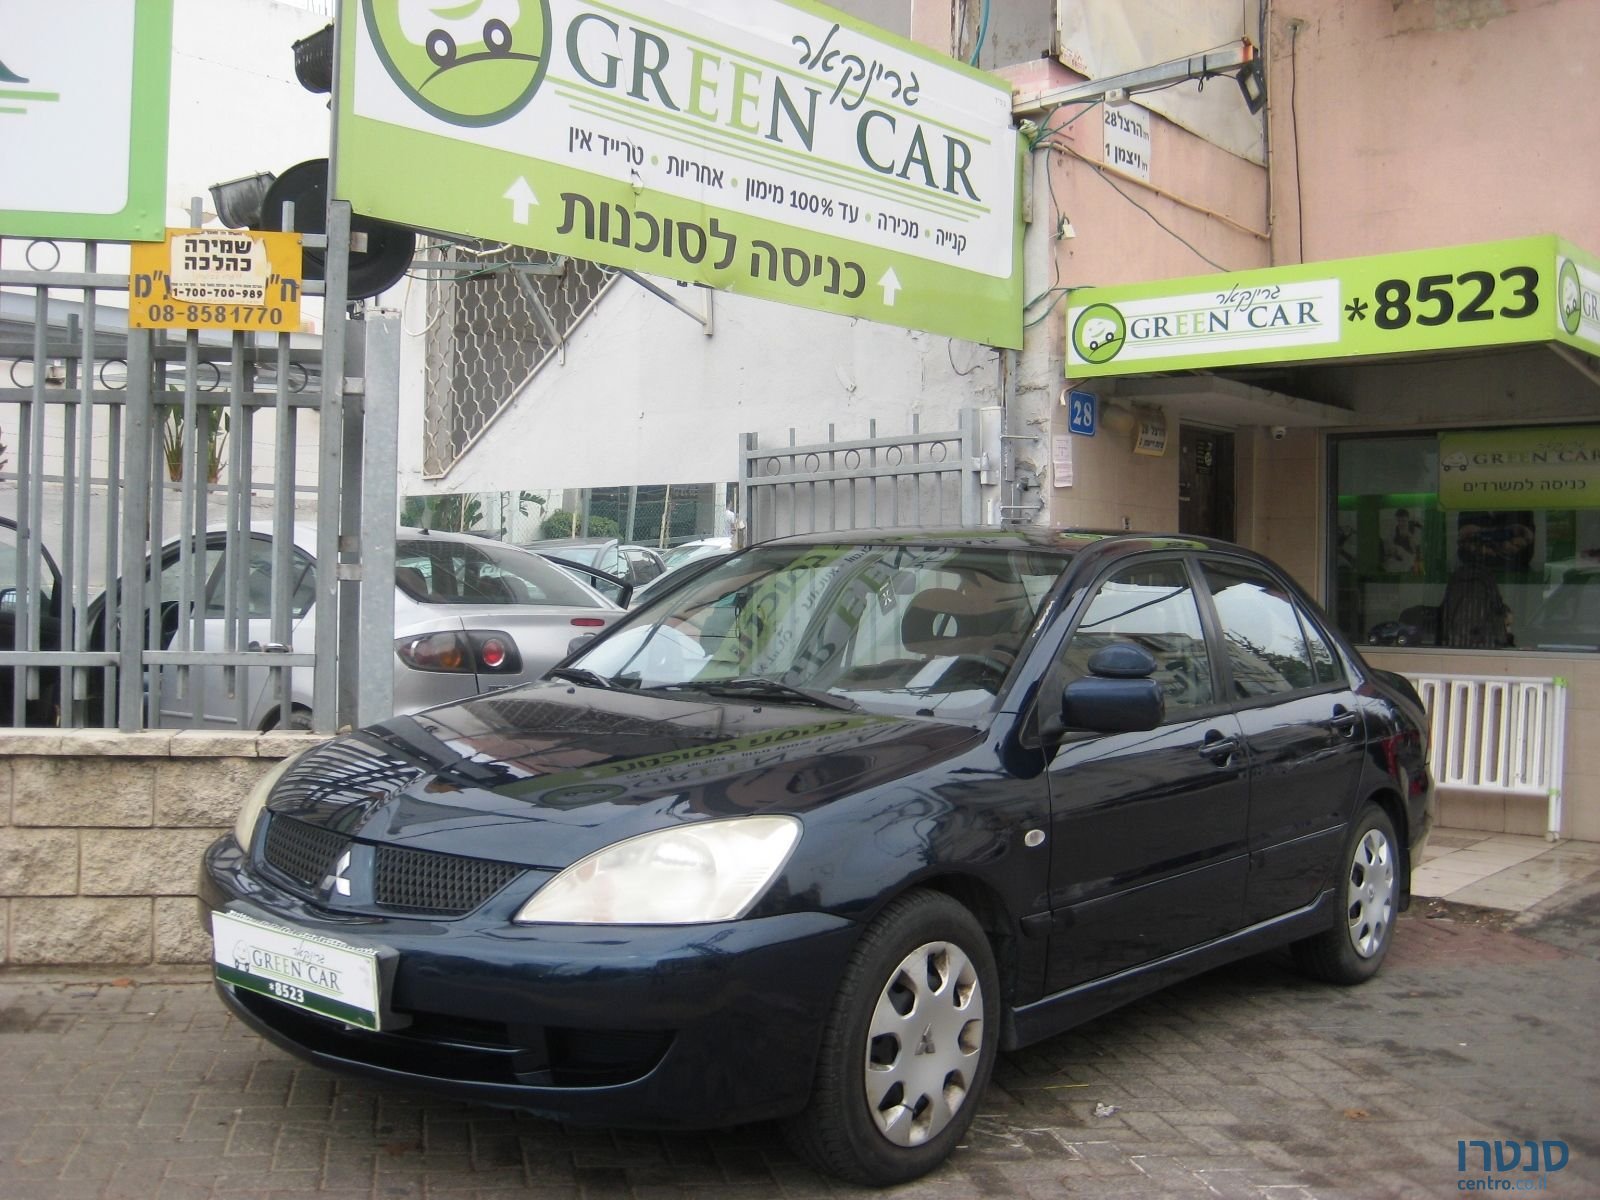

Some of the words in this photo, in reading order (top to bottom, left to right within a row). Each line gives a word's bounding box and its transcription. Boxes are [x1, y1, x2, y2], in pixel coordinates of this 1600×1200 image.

[566, 13, 822, 152] GREEN
[856, 109, 981, 202] CAR
[569, 126, 592, 152] אין
[598, 134, 644, 165] טרייד
[1104, 143, 1110, 157] 1
[1114, 146, 1141, 168] ויצמן
[666, 156, 724, 188] אחריות
[746, 178, 784, 205] מימון
[789, 190, 834, 217] 100%
[839, 202, 860, 223] עד
[556, 192, 737, 270] לסוכנות
[878, 213, 919, 239] מכירה
[185, 239, 252, 255] שמירה
[936, 229, 967, 256] קנייה
[185, 255, 252, 272] כהלכה
[750, 240, 866, 299] כניסה
[173, 288, 263, 299] 1-700-700-989
[149, 304, 283, 325] 08-8581770
[1130, 309, 1231, 340] GREEN
[1247, 301, 1321, 329] CAR
[1073, 400, 1093, 427] 28
[1473, 450, 1548, 465] GREEN
[1463, 477, 1534, 492] למשרדים
[1540, 479, 1587, 491] כניסה
[252, 949, 302, 978] GREEN
[308, 965, 340, 991] CAR
